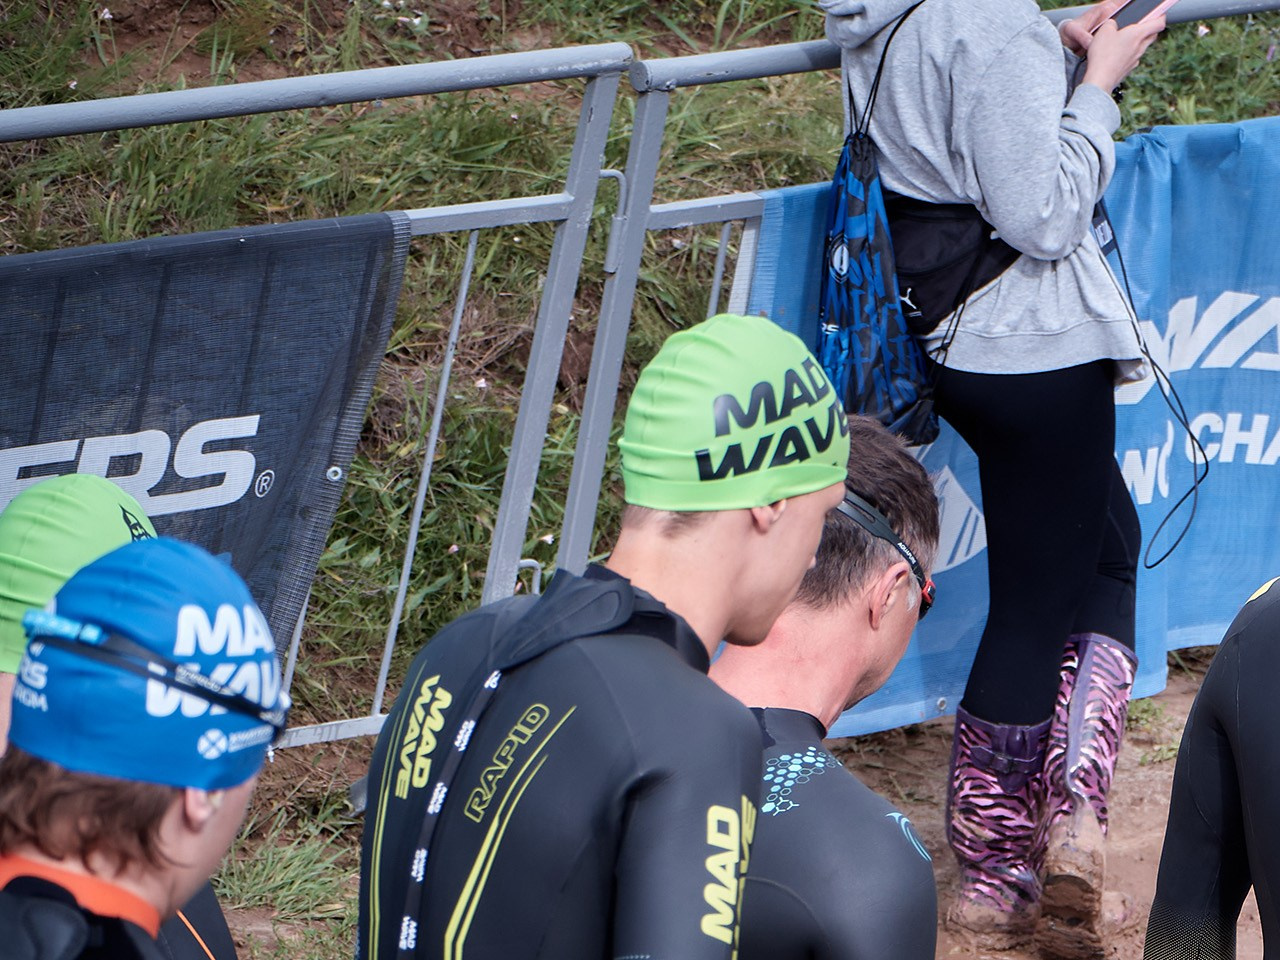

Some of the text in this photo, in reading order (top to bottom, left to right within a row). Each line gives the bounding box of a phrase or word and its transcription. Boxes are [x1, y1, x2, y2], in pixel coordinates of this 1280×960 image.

[713, 357, 831, 438] MAD
[395, 674, 441, 800] WAVE
[412, 687, 452, 789] MAD
[464, 703, 550, 822] RAPID
[701, 805, 740, 945] MAD
